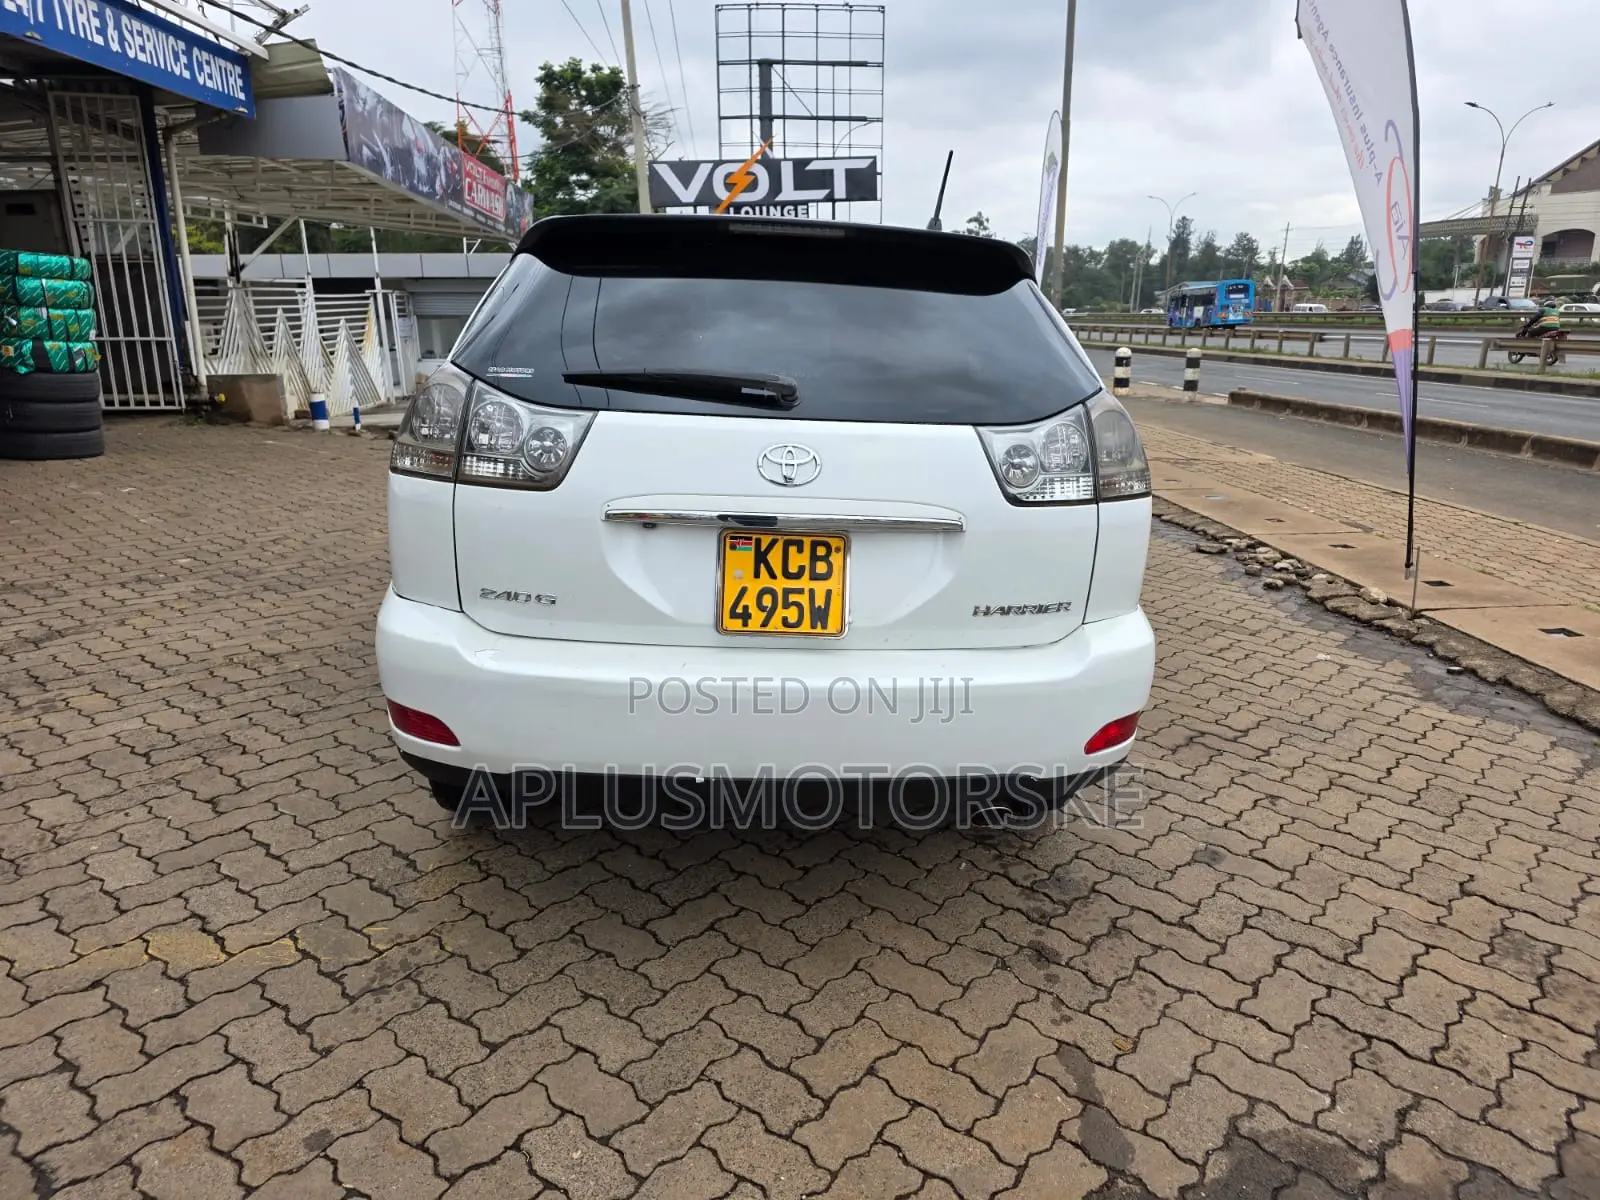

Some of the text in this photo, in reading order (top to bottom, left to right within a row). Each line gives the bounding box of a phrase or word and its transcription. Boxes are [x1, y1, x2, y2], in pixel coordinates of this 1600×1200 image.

[51, 0, 104, 46] TYRE
[105, 8, 121, 53] &
[121, 16, 191, 79] SERVICE
[193, 46, 246, 100] CENTRE
[652, 158, 875, 204] VOLT
[729, 204, 809, 219] LOUNGE
[753, 537, 834, 581] KCB
[729, 586, 833, 630] 495W
[972, 601, 1073, 617] HARRIER
